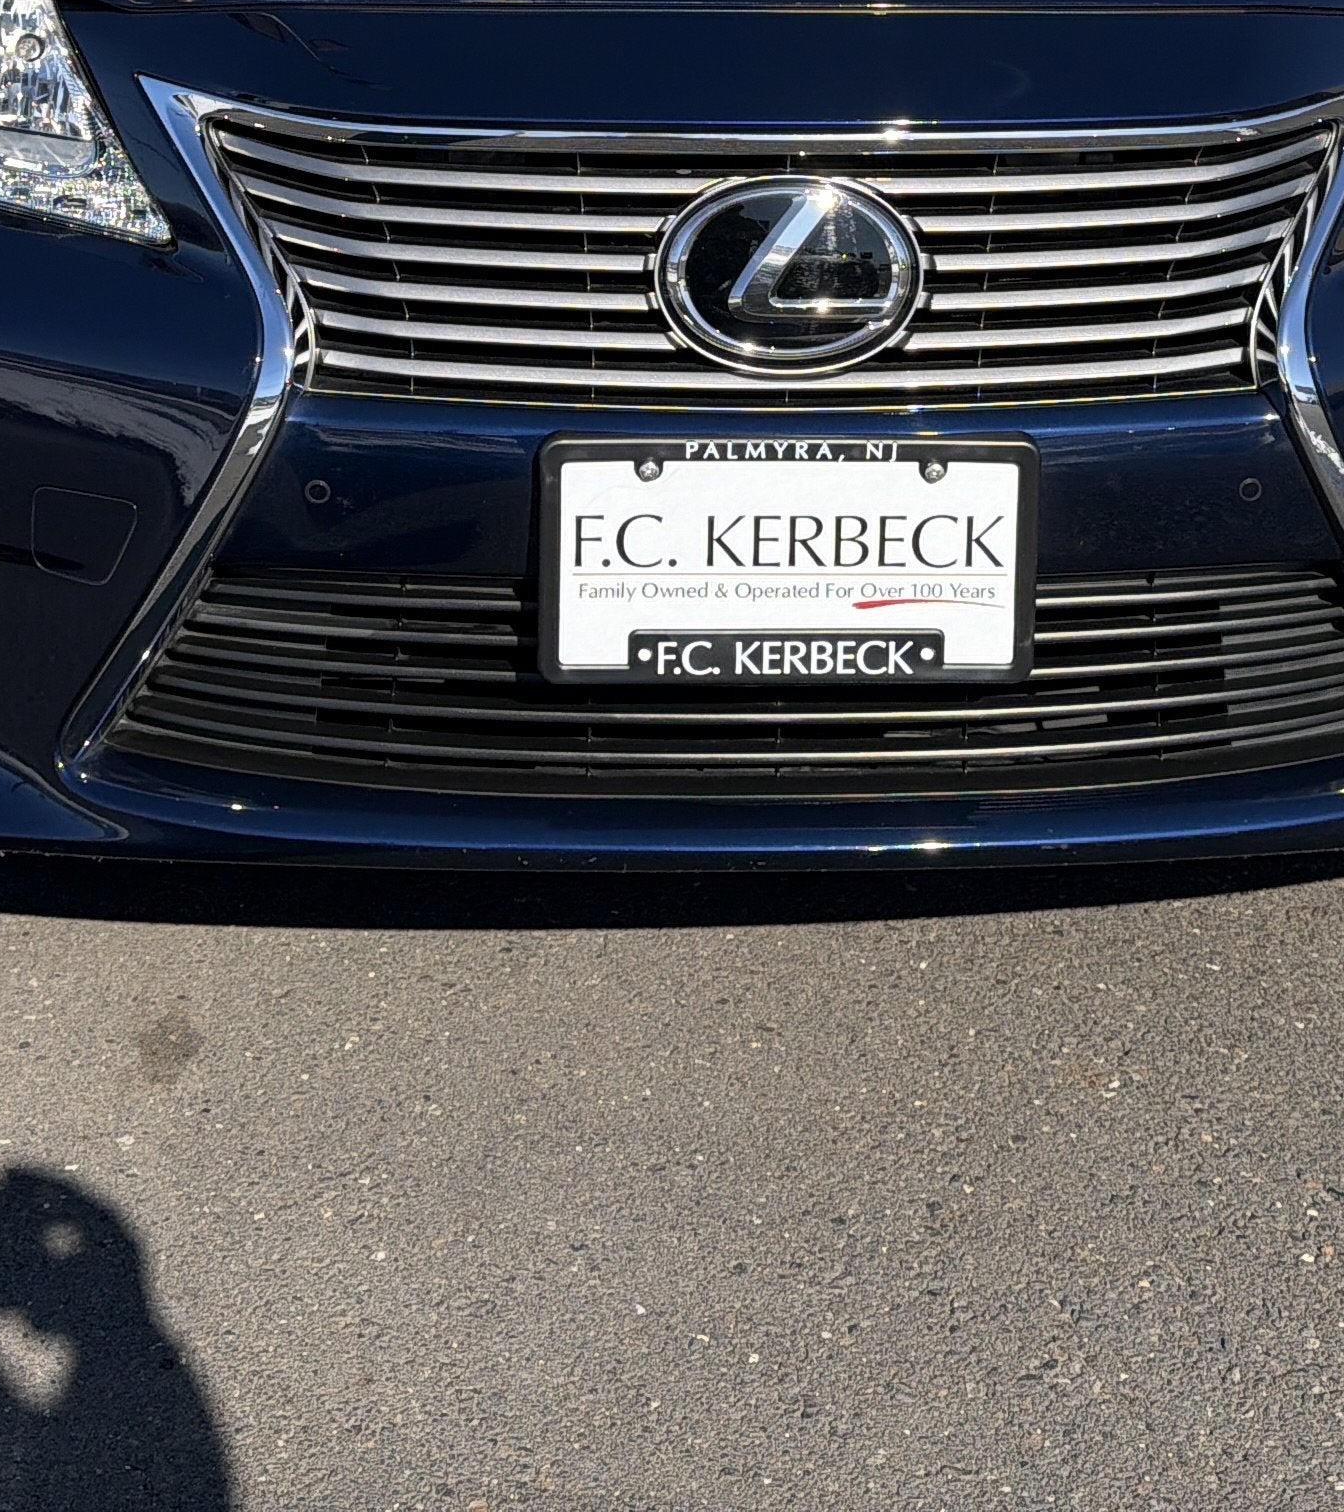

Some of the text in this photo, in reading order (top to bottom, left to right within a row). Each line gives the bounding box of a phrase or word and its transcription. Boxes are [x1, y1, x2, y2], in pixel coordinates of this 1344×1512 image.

[685, 440, 899, 463] PALMYRA, NJ
[574, 514, 1005, 568] F.C. KERBECK
[579, 582, 996, 602] Family Owned & Operated For Over 100 Years
[657, 640, 914, 675] F.C. KERBECK
